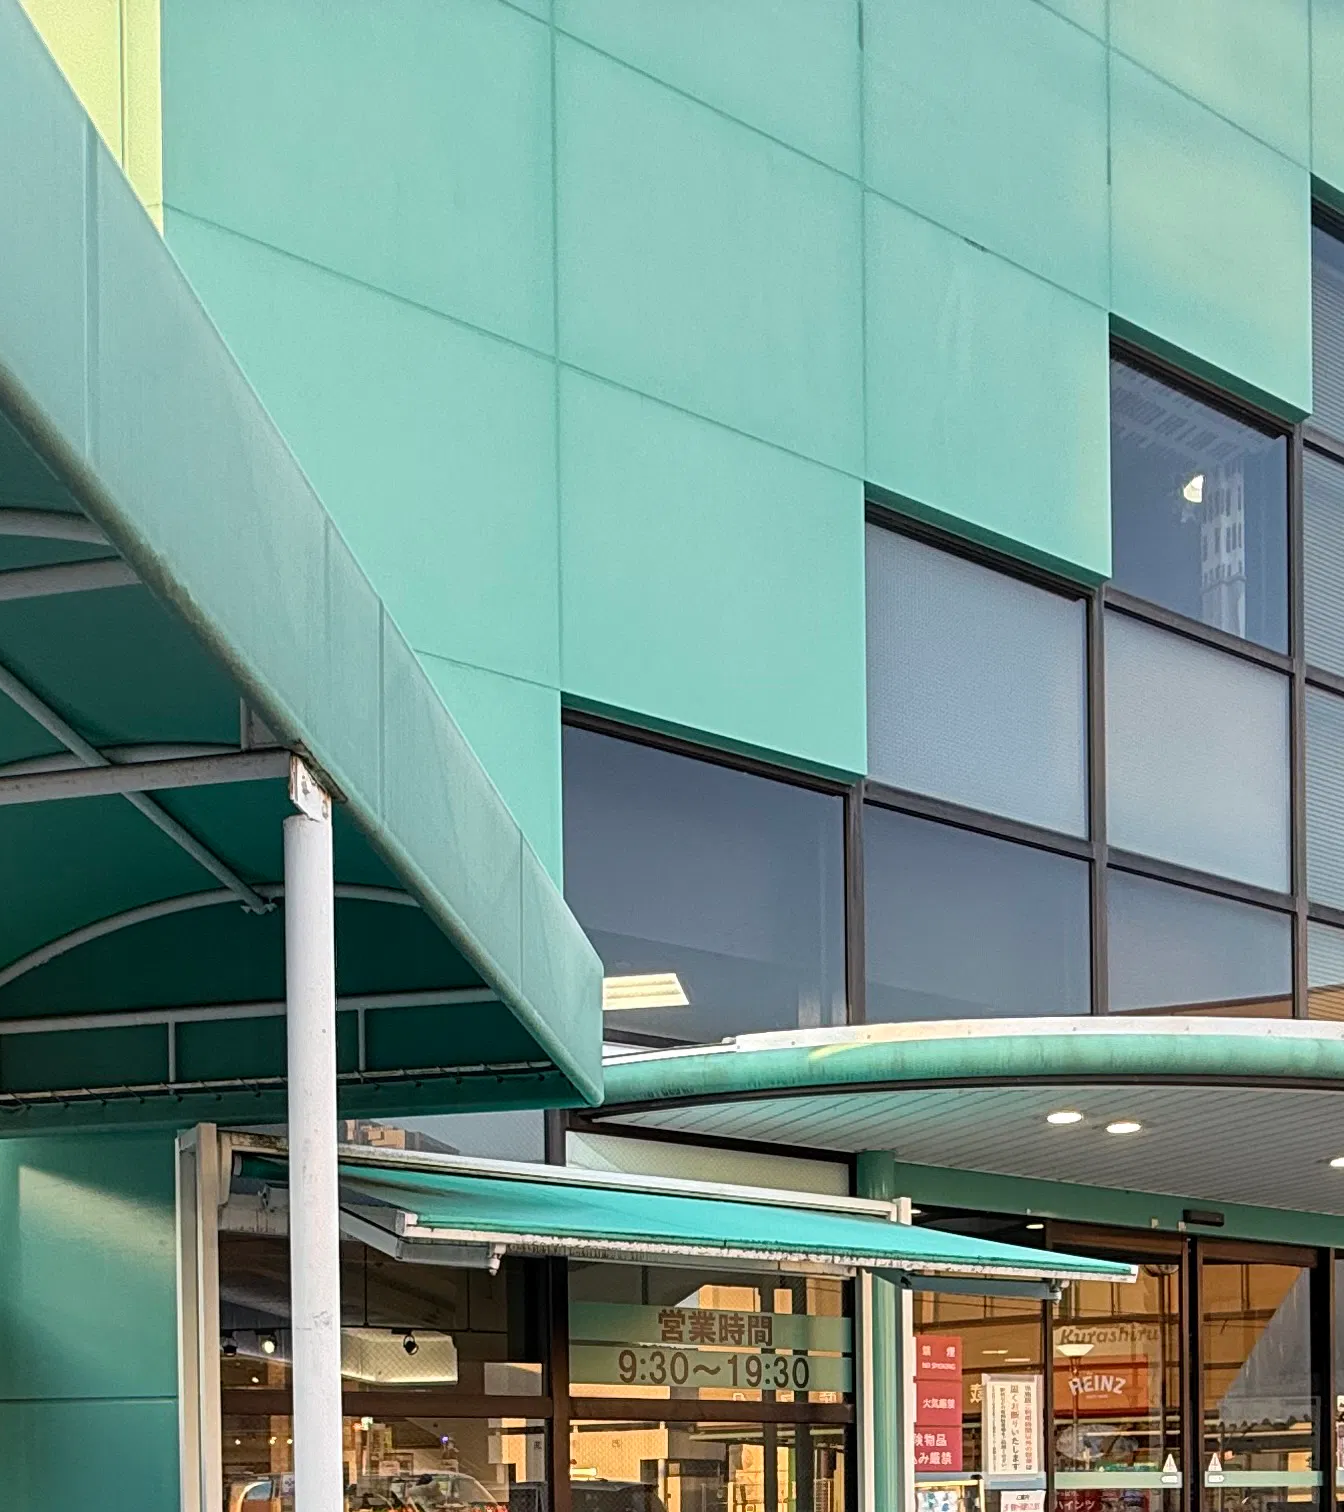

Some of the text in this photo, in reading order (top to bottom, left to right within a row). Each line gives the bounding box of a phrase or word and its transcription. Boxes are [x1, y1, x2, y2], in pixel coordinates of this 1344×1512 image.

[657, 1308, 775, 1347] 営業時間
[1059, 1325, 1159, 1345] Kurashiru
